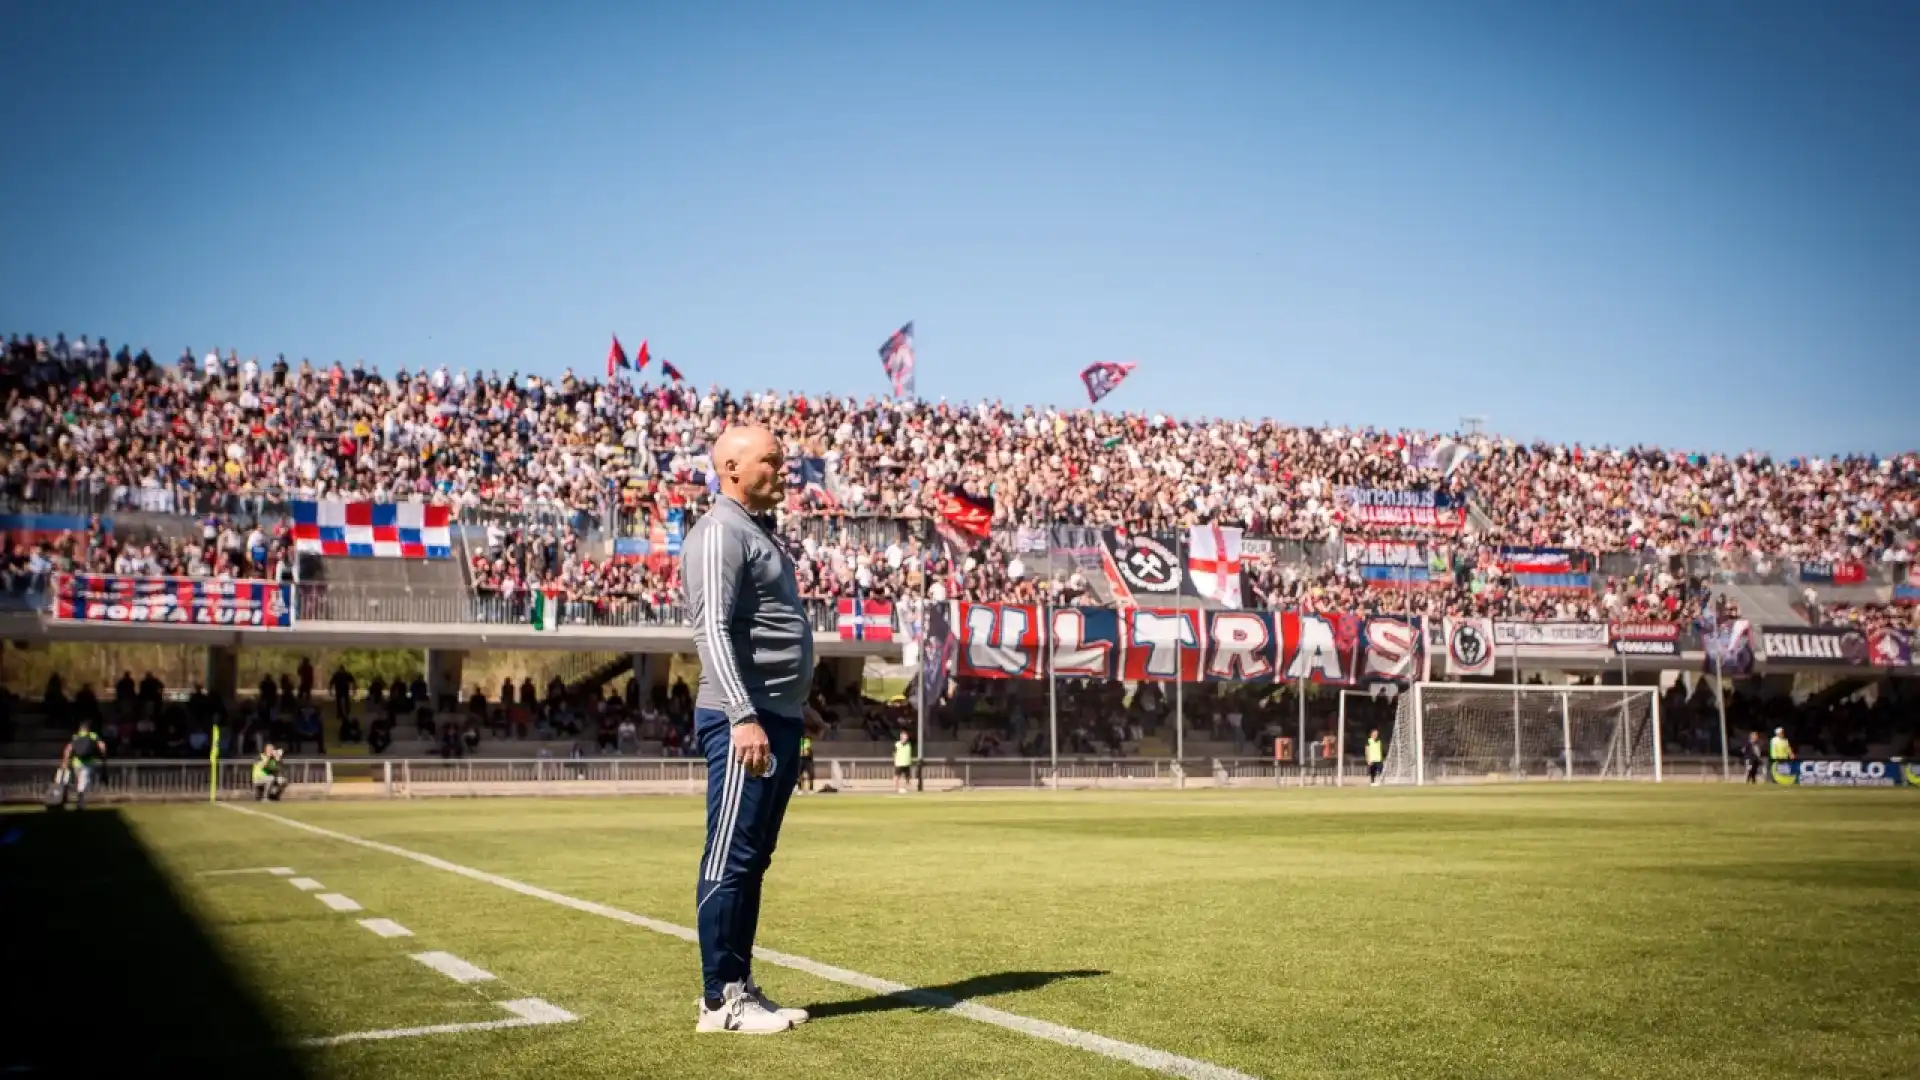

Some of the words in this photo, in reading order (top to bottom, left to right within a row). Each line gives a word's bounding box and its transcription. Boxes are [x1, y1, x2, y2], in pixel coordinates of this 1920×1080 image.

[87, 604, 189, 622] FORZA
[197, 607, 263, 625] LUPI
[968, 606, 1421, 679] ULTRAS
[1764, 633, 1843, 658] ESILIATI
[1800, 761, 1885, 778] CEFALO
